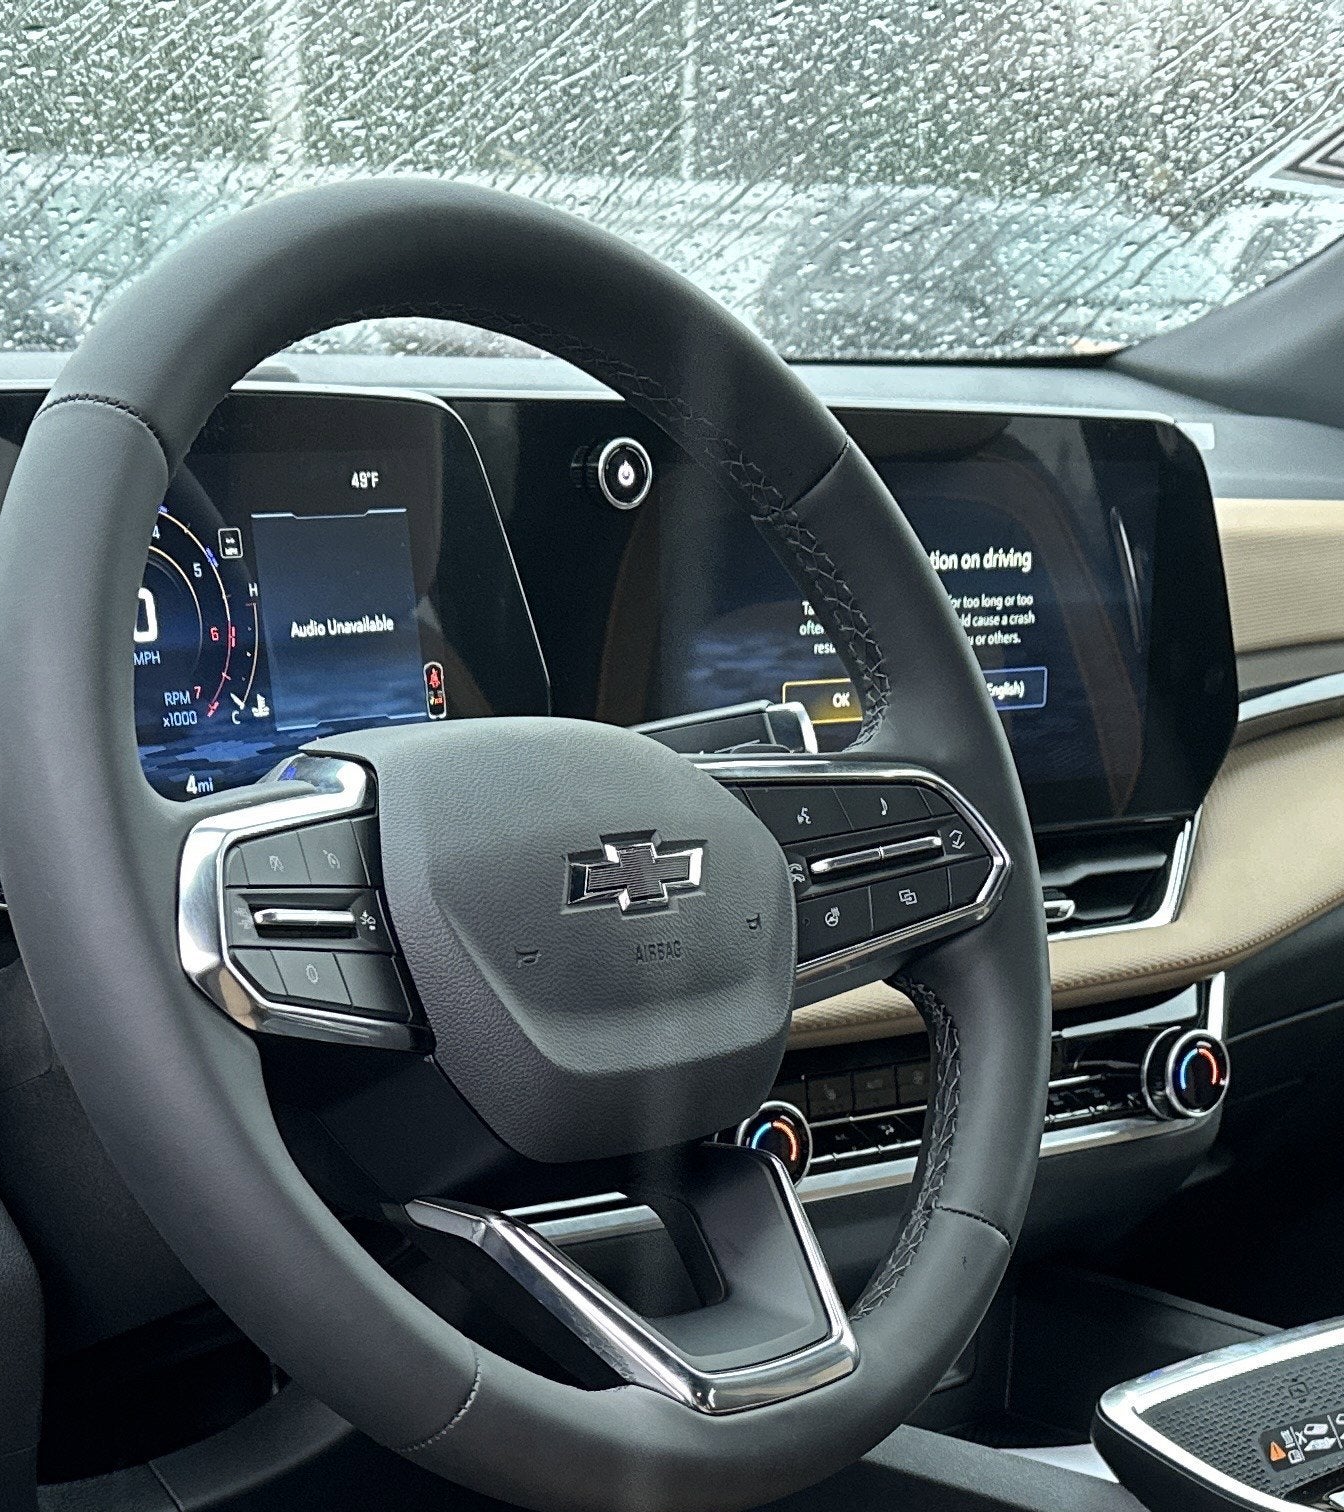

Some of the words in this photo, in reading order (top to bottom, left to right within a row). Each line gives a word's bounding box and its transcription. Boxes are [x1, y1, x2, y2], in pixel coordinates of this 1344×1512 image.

[960, 552, 981, 570] on
[982, 546, 1032, 573] driving
[192, 561, 203, 578] 5
[248, 582, 259, 597] H
[963, 595, 980, 609] too
[981, 593, 1003, 611] long
[1004, 595, 1016, 607] or
[1016, 593, 1034, 606] too
[291, 619, 325, 638] Audio
[326, 614, 395, 636] Unavailable
[799, 619, 826, 636] ofte
[972, 614, 1000, 628] cause
[1000, 614, 1008, 626] a
[1008, 611, 1035, 626] crash
[209, 626, 220, 642] 6
[975, 634, 987, 646] or
[987, 630, 1022, 645] others.
[133, 650, 161, 666] MPH
[163, 690, 192, 707] RPM
[193, 685, 202, 699] 7
[832, 691, 851, 708] OK
[162, 710, 198, 728] x1000
[231, 710, 241, 725] C
[634, 940, 683, 964] AIRBAG
